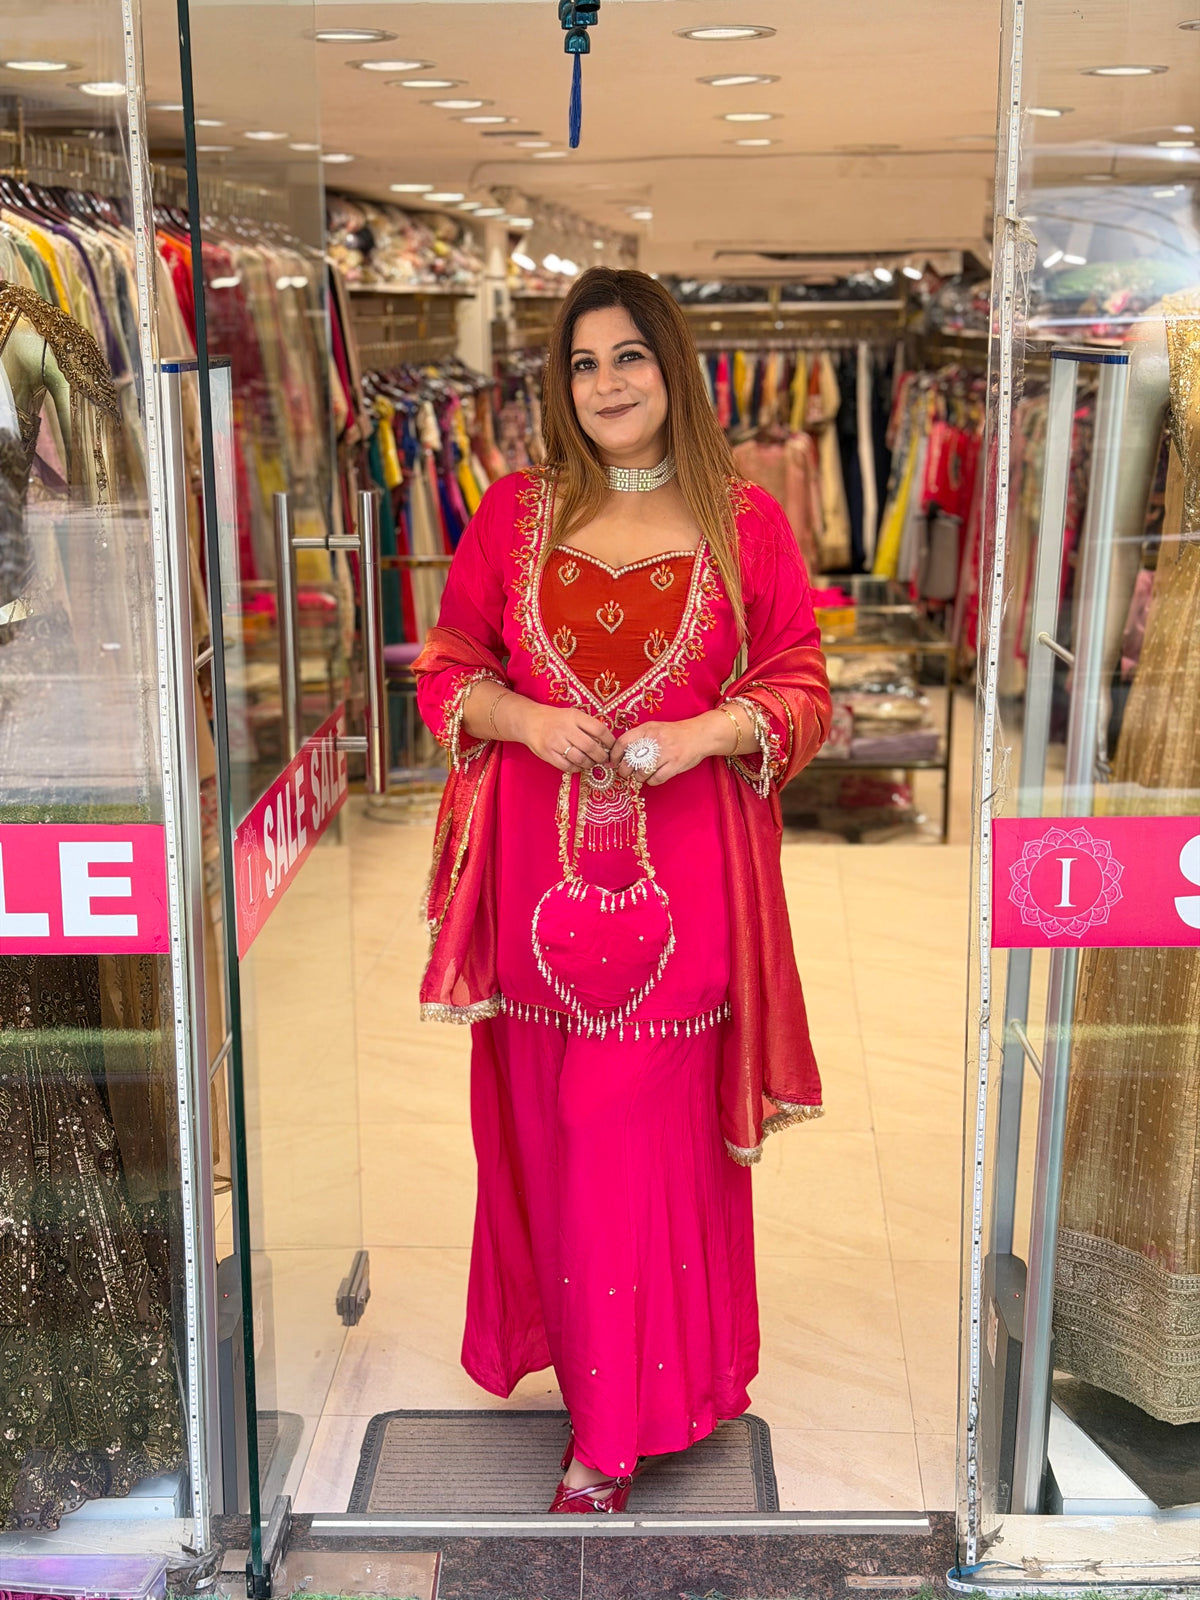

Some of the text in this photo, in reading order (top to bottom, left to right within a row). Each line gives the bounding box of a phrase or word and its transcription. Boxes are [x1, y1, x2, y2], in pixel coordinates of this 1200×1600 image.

[263, 764, 307, 898] SALE
[311, 717, 346, 831] SALE
[1054, 857, 1078, 908] I
